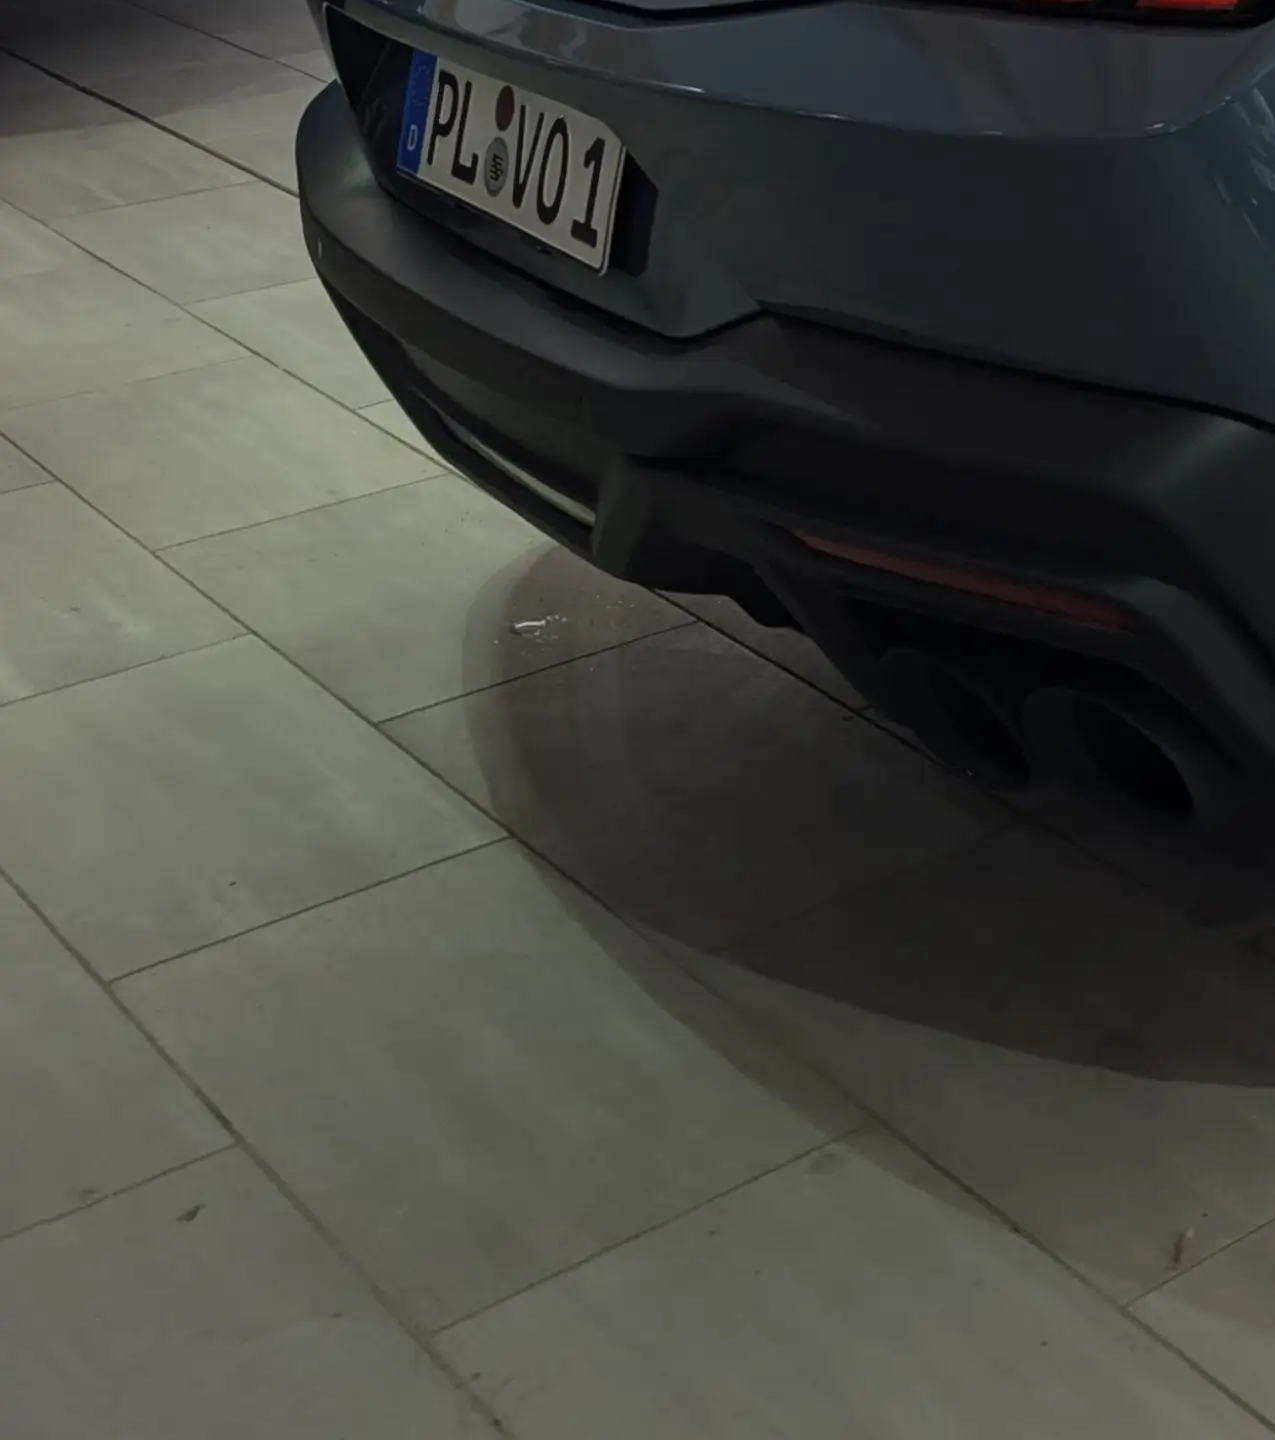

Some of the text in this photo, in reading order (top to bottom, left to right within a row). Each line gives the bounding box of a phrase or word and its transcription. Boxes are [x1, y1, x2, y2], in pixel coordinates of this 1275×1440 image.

[406, 124, 418, 152] D
[428, 69, 606, 248] PL VO 1
